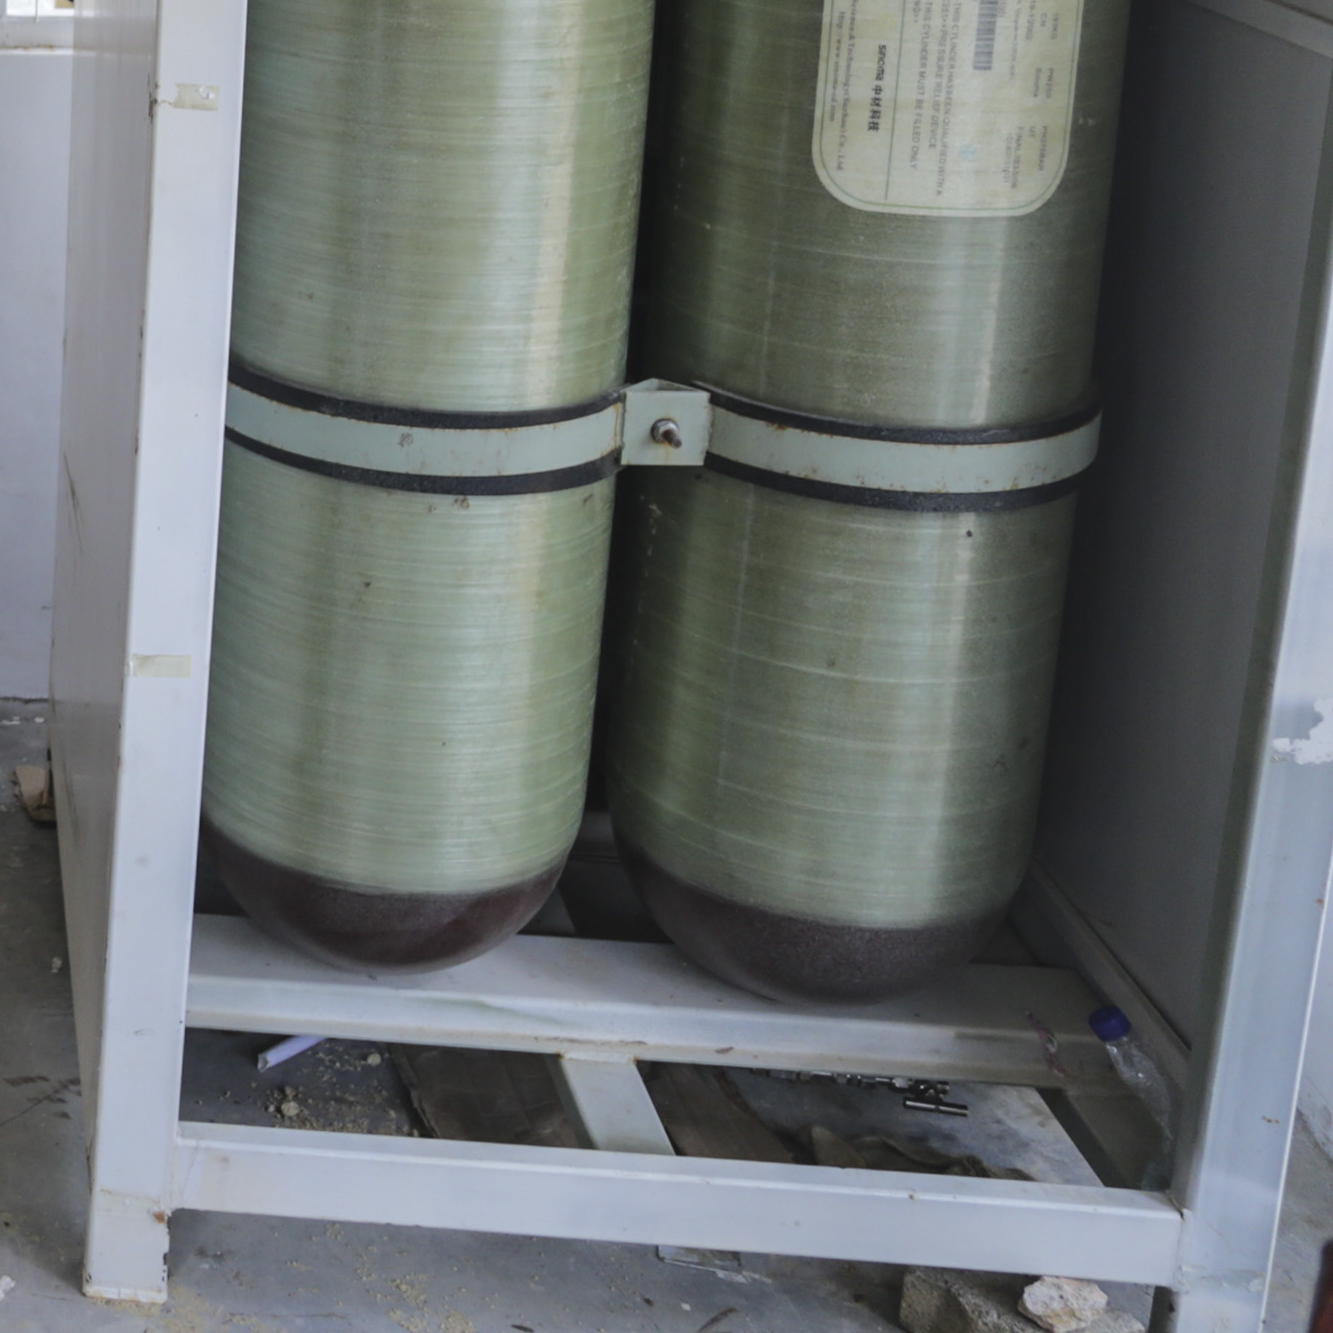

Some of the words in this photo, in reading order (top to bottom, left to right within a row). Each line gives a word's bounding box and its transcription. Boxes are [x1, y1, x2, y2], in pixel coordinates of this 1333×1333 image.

[875, 44, 887, 81] sinoma
[919, 24, 931, 69] CYLINDER
[949, 25, 958, 69] CYLINDER
[917, 71, 926, 96] MUST
[933, 82, 942, 114] RELIEF
[867, 84, 884, 133] 中材科技
[915, 99, 923, 111] BE
[912, 113, 923, 143] FILLED
[929, 116, 939, 149] DEVICE
[939, 117, 951, 164] QUALIFIED
[910, 146, 919, 170] ONLY
